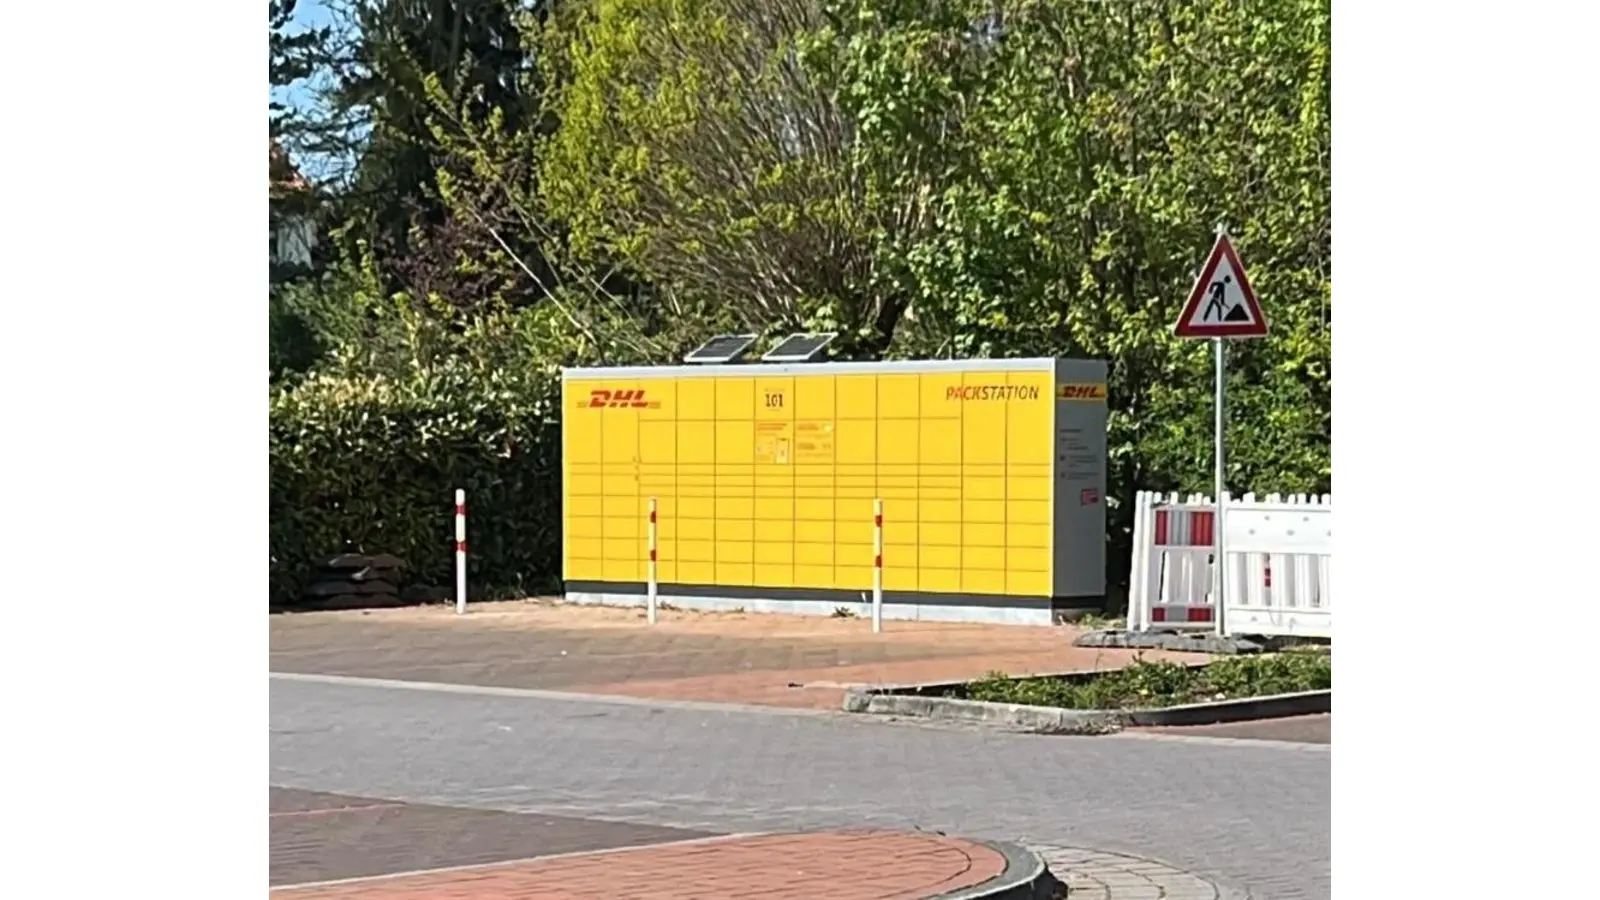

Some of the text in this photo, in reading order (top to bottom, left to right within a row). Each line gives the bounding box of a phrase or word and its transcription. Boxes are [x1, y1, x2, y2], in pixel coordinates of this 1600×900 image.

[589, 390, 648, 408] DHL
[946, 385, 1040, 400] PACKSTATION
[1062, 385, 1100, 399] DHL
[765, 393, 784, 408] 101
